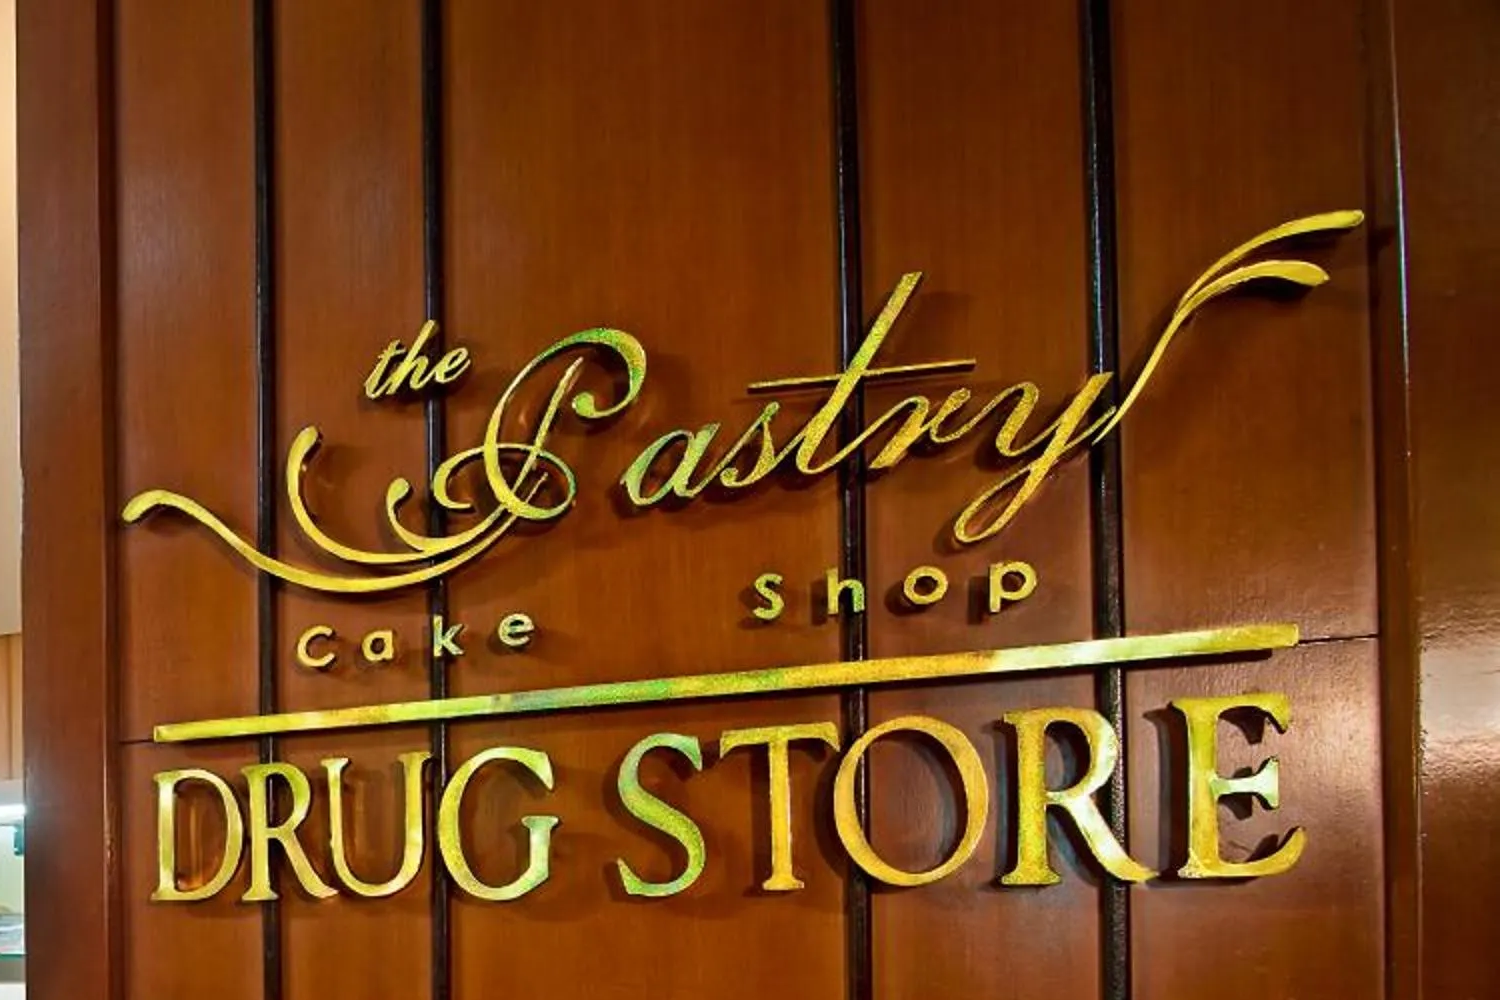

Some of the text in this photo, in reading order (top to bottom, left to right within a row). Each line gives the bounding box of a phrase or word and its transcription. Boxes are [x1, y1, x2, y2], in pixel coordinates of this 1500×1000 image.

[363, 319, 470, 400] the
[296, 560, 1039, 668] cake shop
[150, 692, 1307, 903] DRUG STORE
